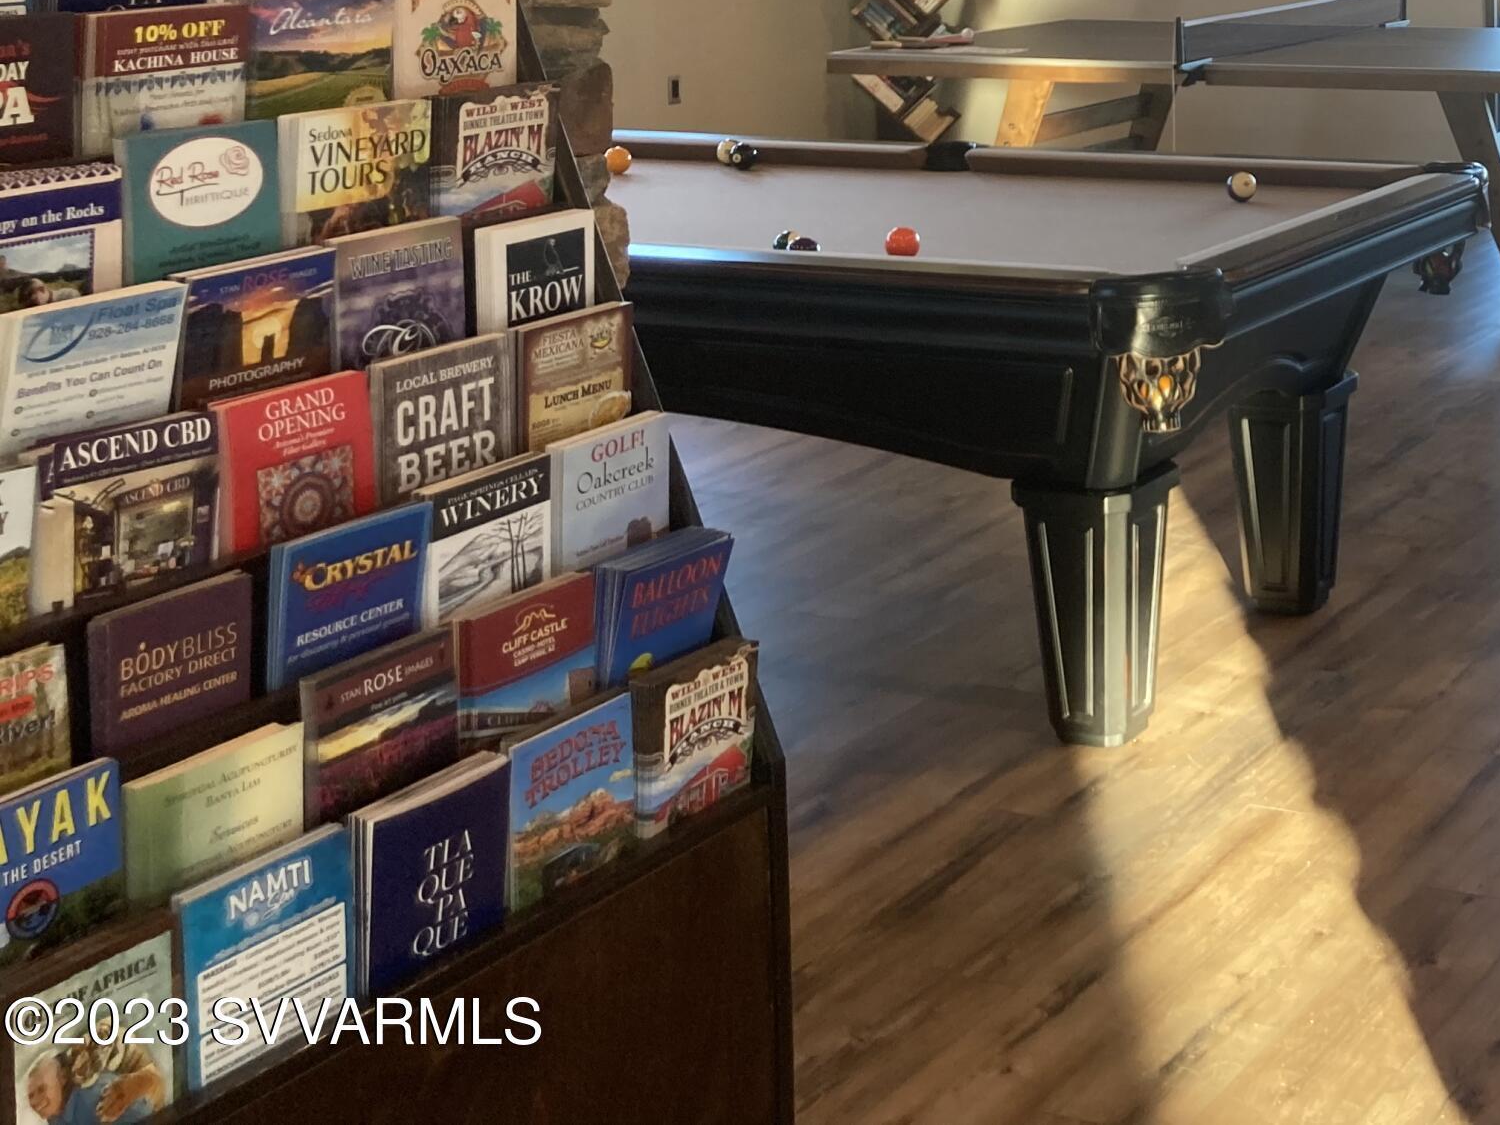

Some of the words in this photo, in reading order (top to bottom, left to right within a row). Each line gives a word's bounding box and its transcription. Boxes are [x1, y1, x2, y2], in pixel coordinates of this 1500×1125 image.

[134, 23, 176, 44] 10%
[181, 19, 226, 39] OFF
[112, 51, 184, 73] KACHINA
[190, 47, 238, 63] HOUSE
[463, 118, 487, 131] DINNER
[526, 110, 544, 120] TOWN
[465, 105, 497, 117] WILD
[510, 99, 544, 111] WEST
[310, 129, 426, 168] VINEYARD
[463, 125, 525, 168] BLAZIN'
[527, 124, 544, 155] M
[468, 151, 533, 174] RANCH
[156, 166, 184, 188] Red
[188, 161, 220, 183] Rose
[308, 159, 389, 195] TOURS
[21, 215, 38, 228] on
[41, 209, 62, 224] the
[65, 204, 105, 221] Rocks
[347, 249, 392, 280] WINE
[394, 237, 453, 270] TASTING
[242, 268, 289, 292] ROSE
[509, 271, 532, 287] THE
[510, 274, 583, 323] KROW
[97, 303, 140, 322] Float
[145, 297, 178, 313] Spa
[533, 338, 585, 360] MEXICANA
[542, 328, 578, 346] FIESTA
[17, 381, 62, 400] Benefits
[65, 376, 86, 388] You
[89, 370, 111, 383] Can
[114, 362, 145, 378] Count
[147, 360, 163, 371] On
[208, 357, 305, 391] PHOTOGRAPHY
[395, 372, 438, 394] LOCAL
[440, 356, 495, 381] BREWERY
[265, 387, 334, 420] GRAND
[396, 377, 495, 447] CRAFT
[543, 389, 579, 409] LUNCH
[580, 379, 612, 398] MENU
[258, 403, 345, 442] OPENING
[60, 428, 158, 471] ASCEND
[163, 417, 211, 448] CBD
[397, 429, 496, 494] BEER
[591, 429, 645, 464] GOLF!
[167, 476, 190, 493] CBD
[576, 446, 655, 495] Oakcreek
[440, 473, 545, 528] WINERY
[575, 483, 627, 513] COUNTRY
[628, 474, 654, 492] CLUB
[303, 539, 418, 591] CRYSTAL
[632, 553, 723, 608] BALLOON
[296, 614, 358, 647] RESOURCE
[360, 598, 404, 623] CENTER
[502, 634, 529, 654] CLIFF
[530, 618, 568, 641] CASTLE
[120, 667, 183, 698] FACTORY
[188, 647, 237, 674] DIRECT
[340, 689, 362, 704] STAN
[363, 665, 403, 696] ROSE
[404, 656, 434, 676] IMAGES
[671, 680, 701, 700] WILD
[712, 662, 743, 681] WEST
[120, 700, 158, 721] AROMA
[159, 685, 201, 706] HEALING
[203, 671, 238, 691] CENTER
[670, 695, 692, 713] DINNER
[726, 672, 744, 686] TOWN
[670, 694, 726, 751] BLAZIN'
[728, 686, 744, 717] M
[676, 720, 734, 754] RANCH
[531, 720, 621, 782] SEDONA
[524, 741, 626, 809] TROLLEY
[2, 862, 28, 886] THE
[33, 839, 82, 873] DESERT
[424, 829, 472, 872] TLA
[229, 858, 311, 920] NAMTI
[416, 852, 474, 904] QUE
[436, 888, 467, 922] PA
[412, 910, 468, 957] QUE
[90, 953, 157, 998] AFRICA
